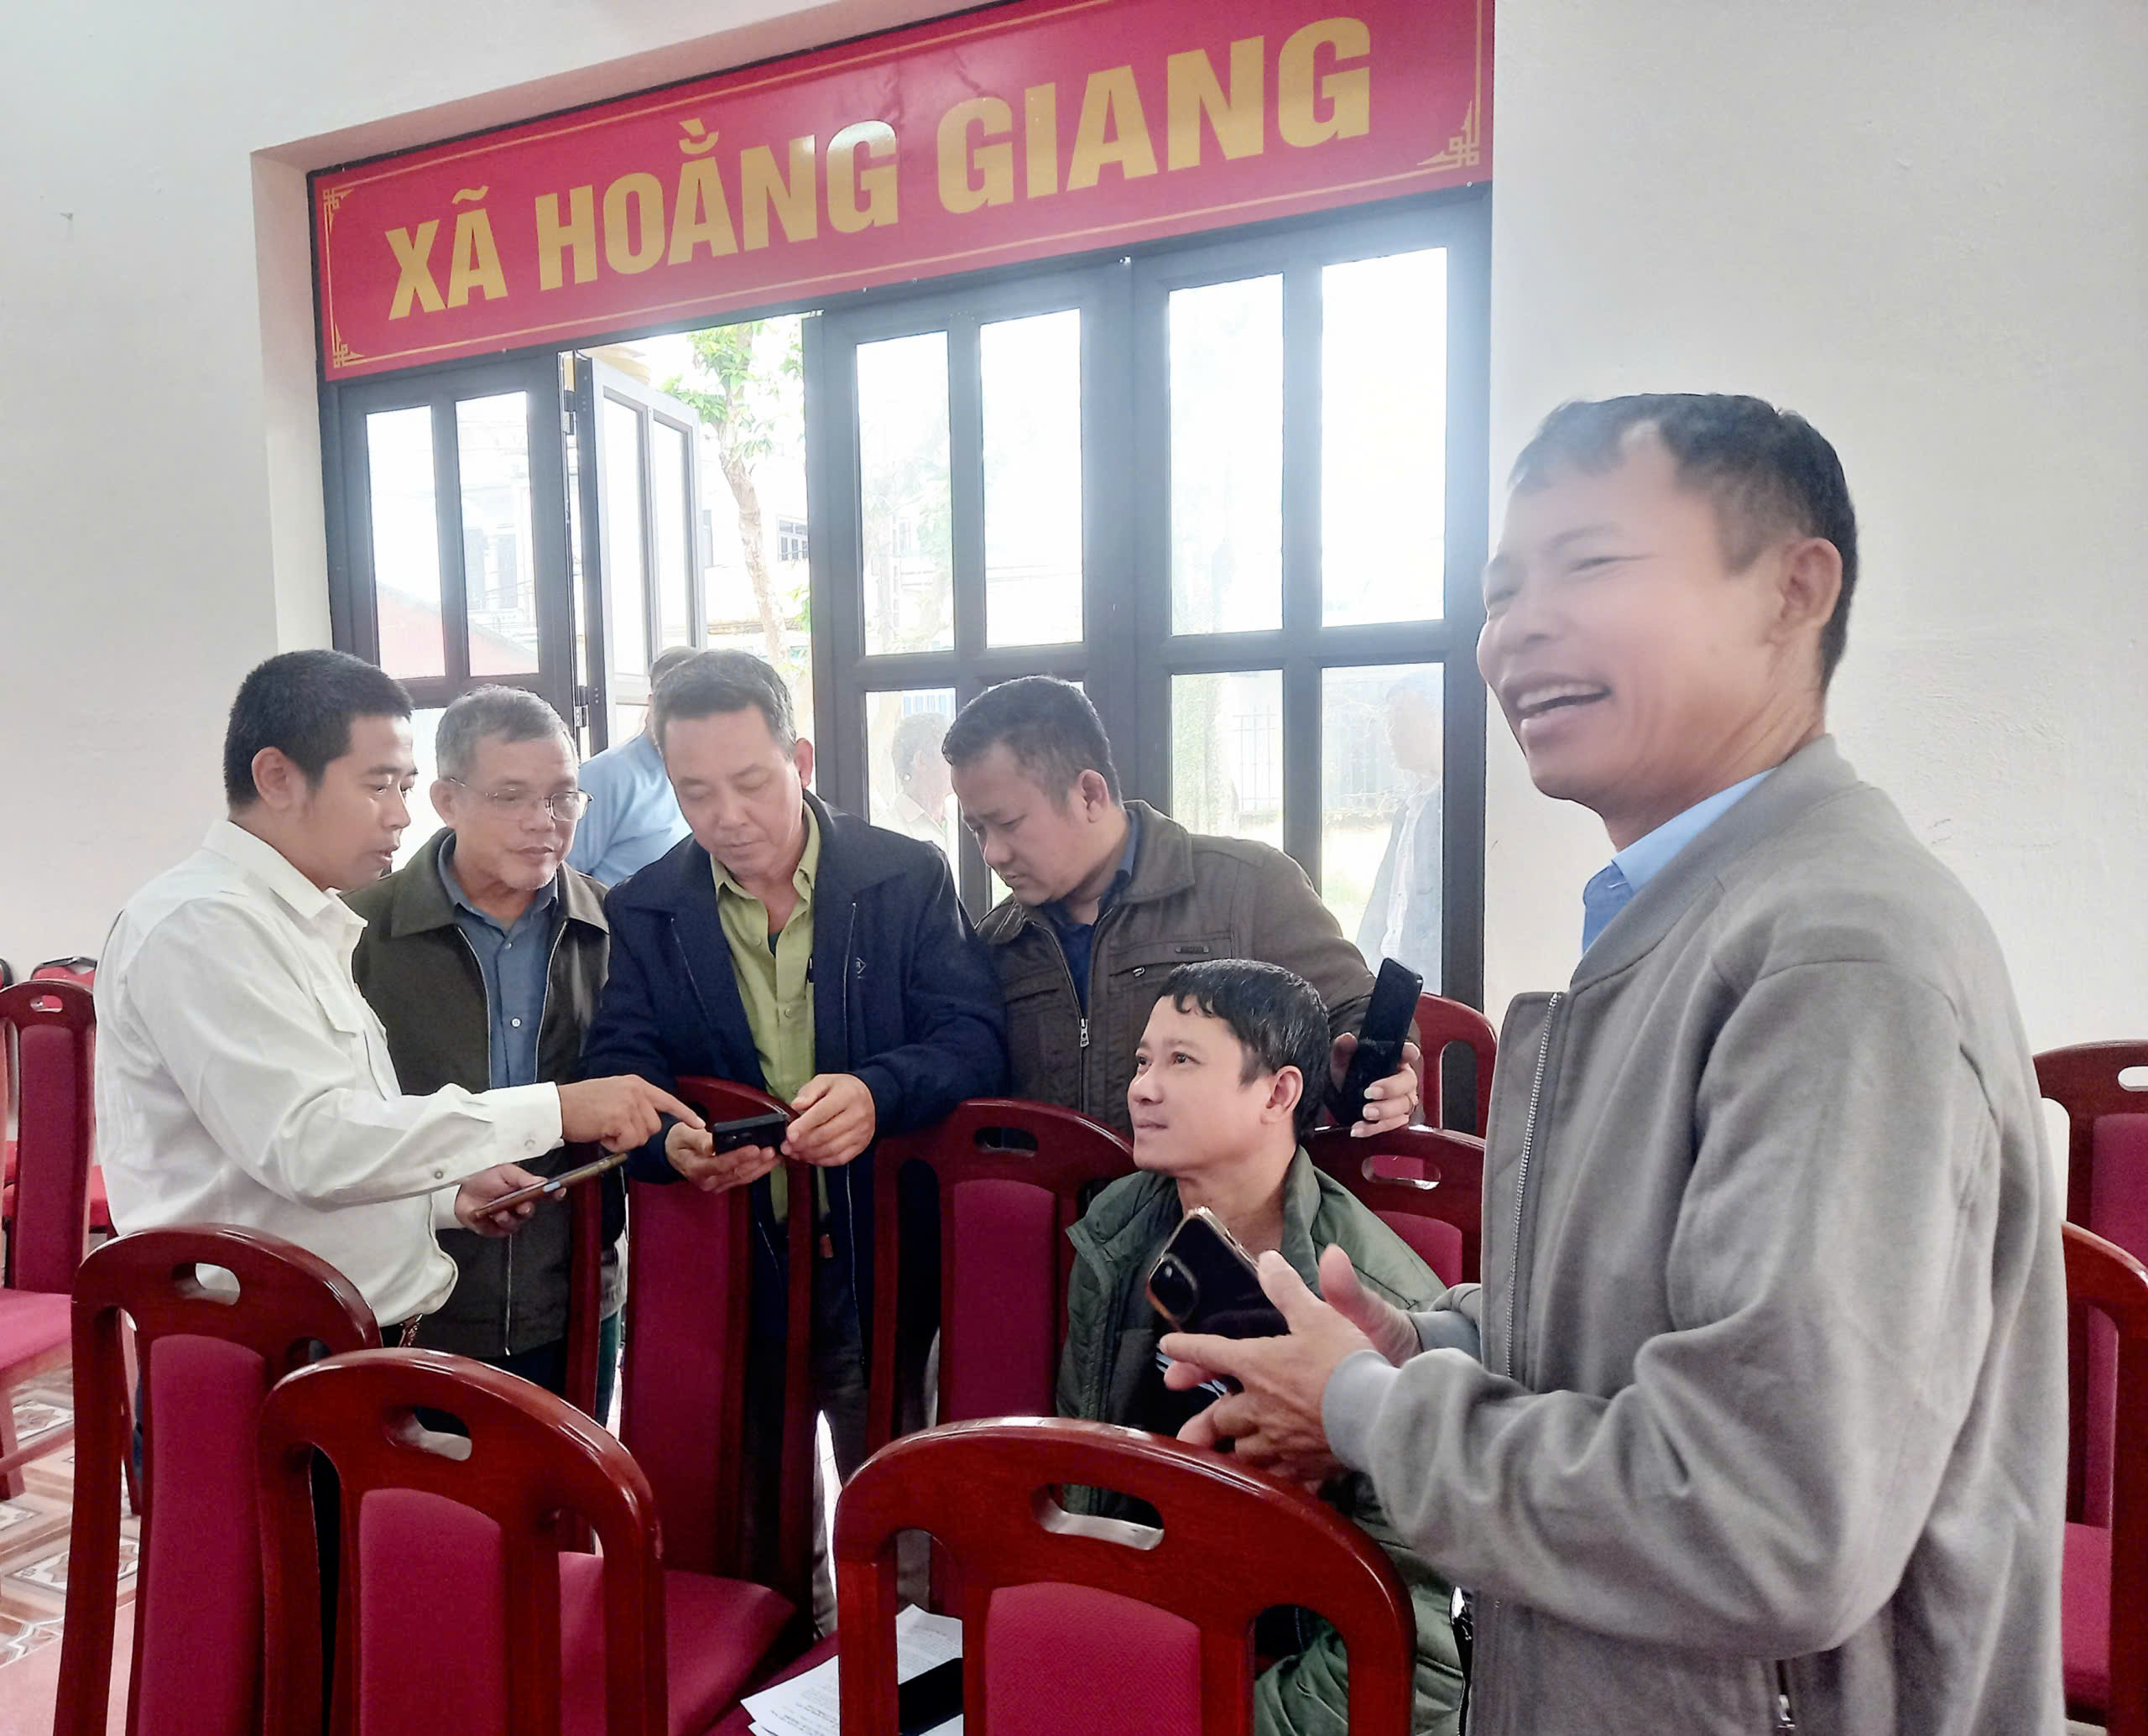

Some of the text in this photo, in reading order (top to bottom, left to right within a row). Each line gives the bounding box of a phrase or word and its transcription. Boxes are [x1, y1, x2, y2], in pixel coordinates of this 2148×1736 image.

[386, 17, 1371, 320] XÃ HOẰNG GIANG
